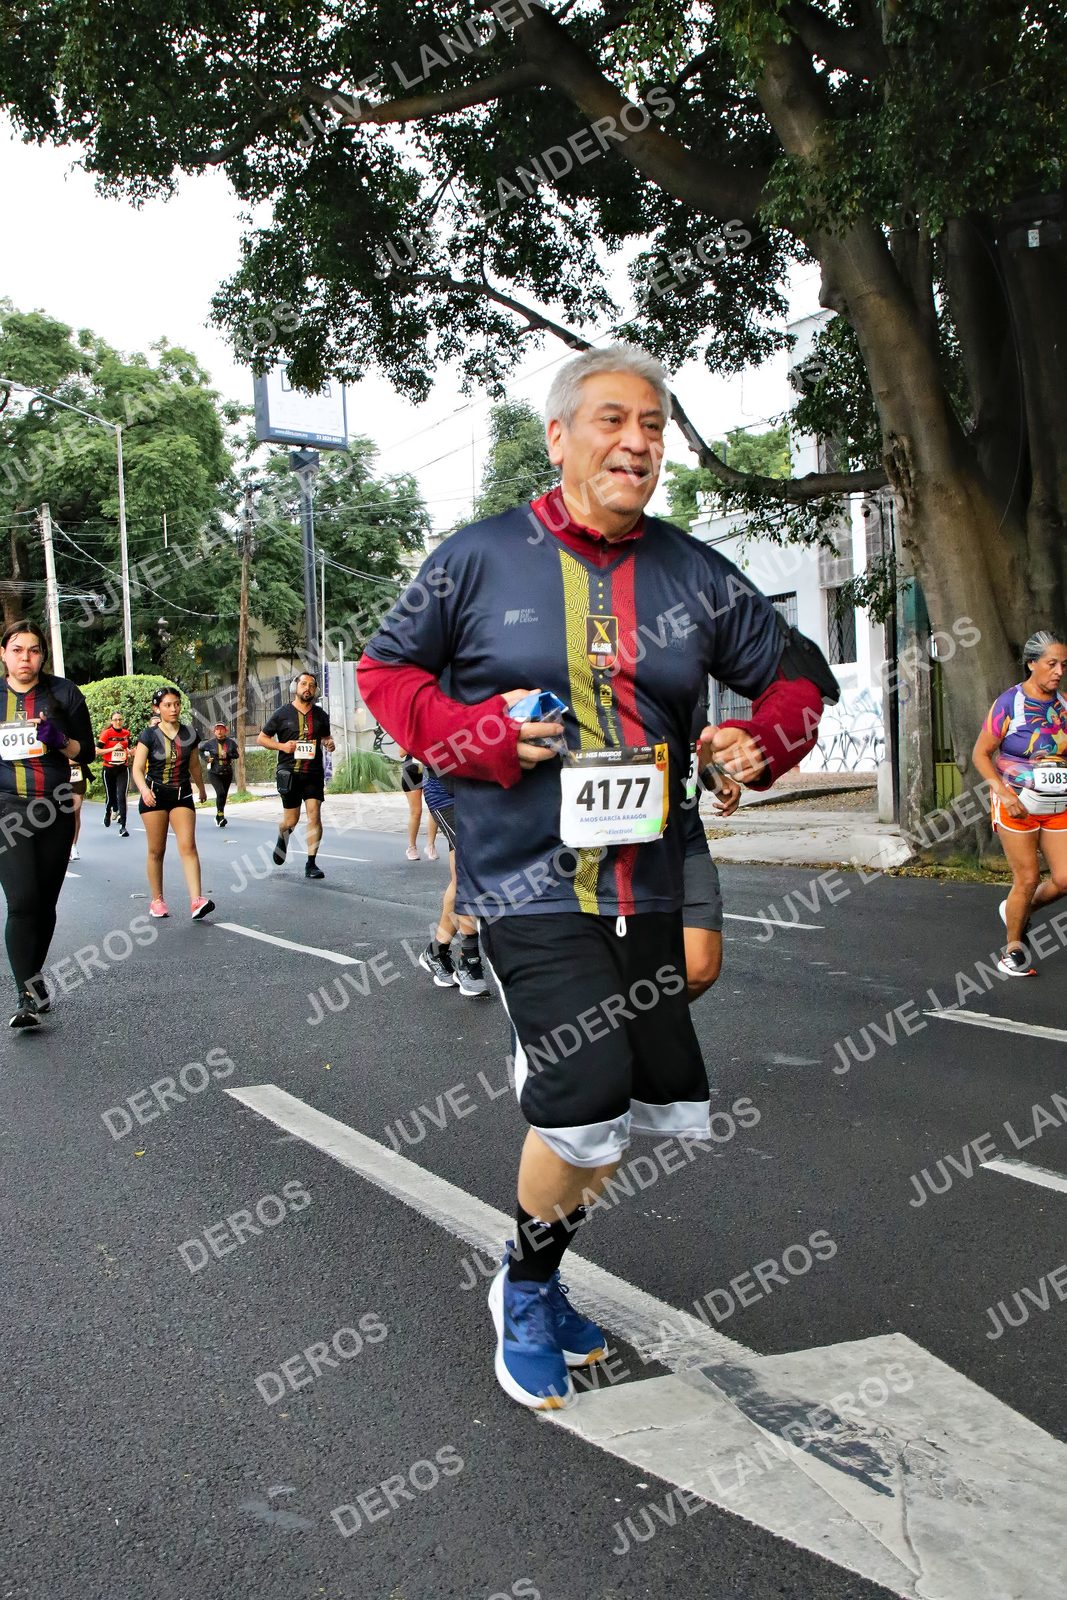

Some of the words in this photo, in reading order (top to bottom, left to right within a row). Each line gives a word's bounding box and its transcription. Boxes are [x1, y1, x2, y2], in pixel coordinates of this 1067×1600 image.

[2, 732, 35, 747] 6916
[1041, 772, 1067, 785] 3083
[576, 777, 650, 811] 4177
